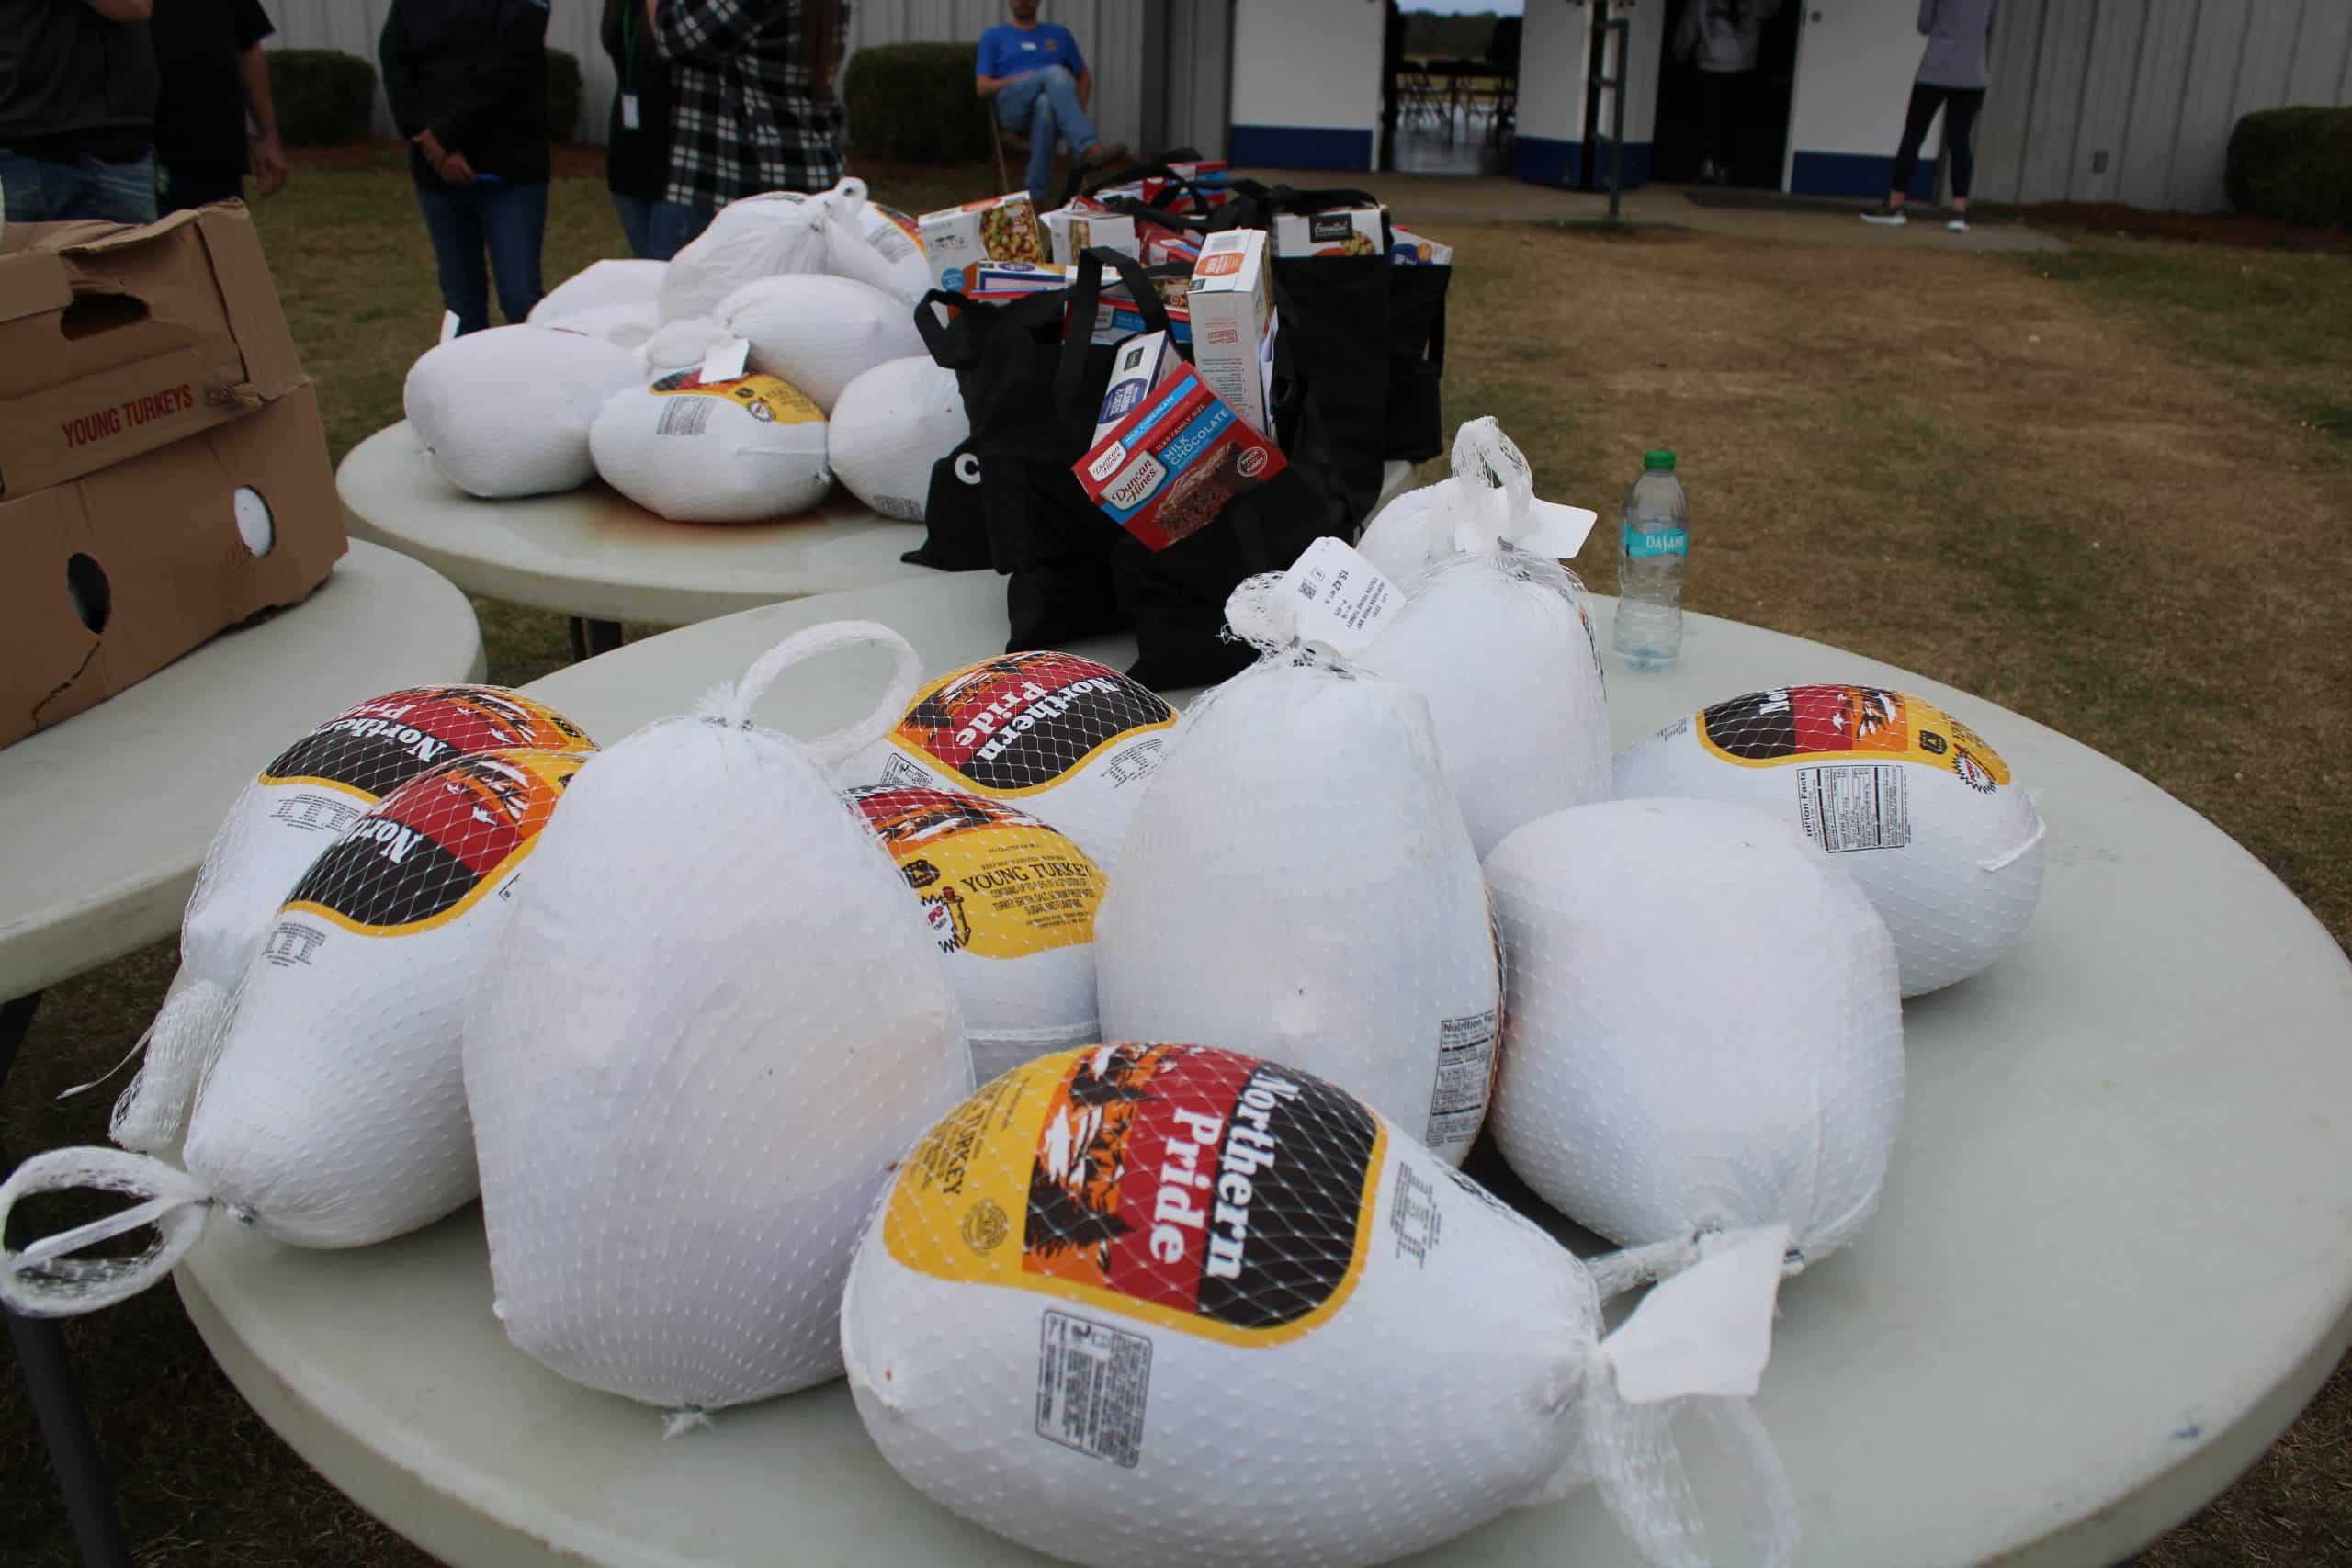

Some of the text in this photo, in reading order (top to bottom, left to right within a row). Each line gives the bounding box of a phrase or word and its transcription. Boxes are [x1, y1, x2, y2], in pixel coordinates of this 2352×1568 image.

[61, 384, 194, 448] YOUNG TURKEYS
[1170, 410, 1229, 466] CHOCOLATE
[1165, 436, 1190, 460] MILK
[1111, 459, 1154, 503] Duncan
[1127, 468, 1158, 503] Hines
[1331, 570, 1349, 592] 15.42
[956, 681, 1047, 746] Pride
[976, 675, 1122, 761] Northern
[961, 866, 1029, 892] YOUNG
[1443, 1019, 1483, 1033] Nutrition
[942, 1110, 985, 1198] TURKEY
[1203, 1065, 1301, 1280] Northern
[1148, 1106, 1225, 1267] Pride
